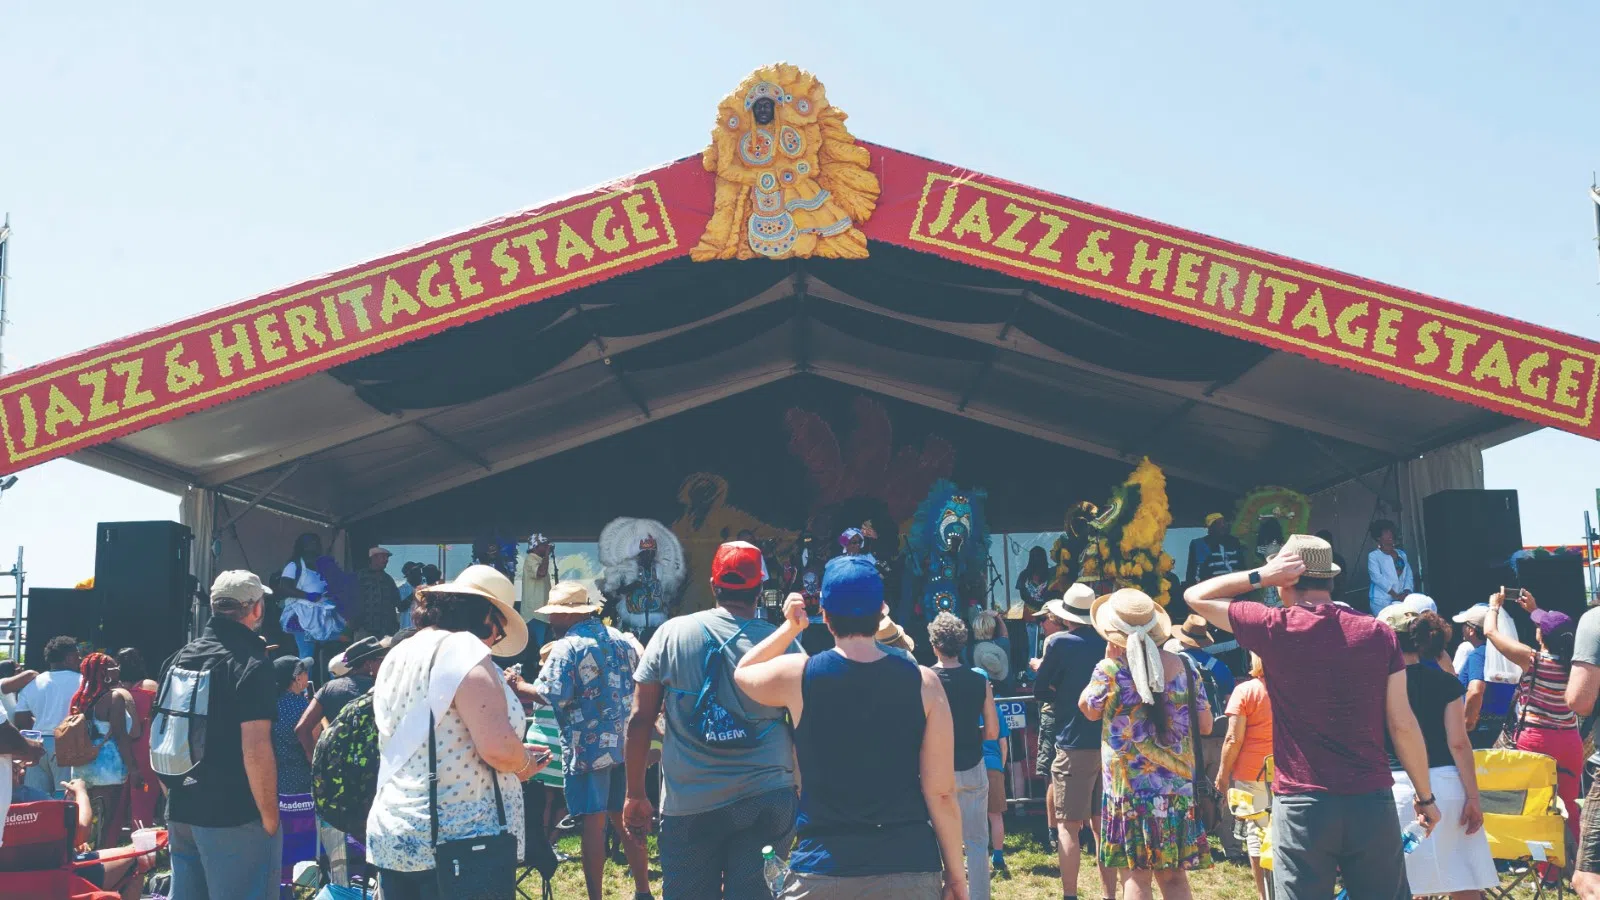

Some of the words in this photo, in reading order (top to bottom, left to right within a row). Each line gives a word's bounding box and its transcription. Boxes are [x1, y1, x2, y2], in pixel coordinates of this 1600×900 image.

[19, 358, 157, 450] JAZZ
[164, 342, 204, 394] &
[209, 249, 485, 378] HERITAGE
[490, 194, 659, 287] STAGE
[927, 186, 1070, 263] JAZZ
[1075, 230, 1115, 277] &
[1125, 240, 1404, 358] HERITAGE
[1413, 320, 1586, 409] STAGE
[279, 801, 315, 809] Academy
